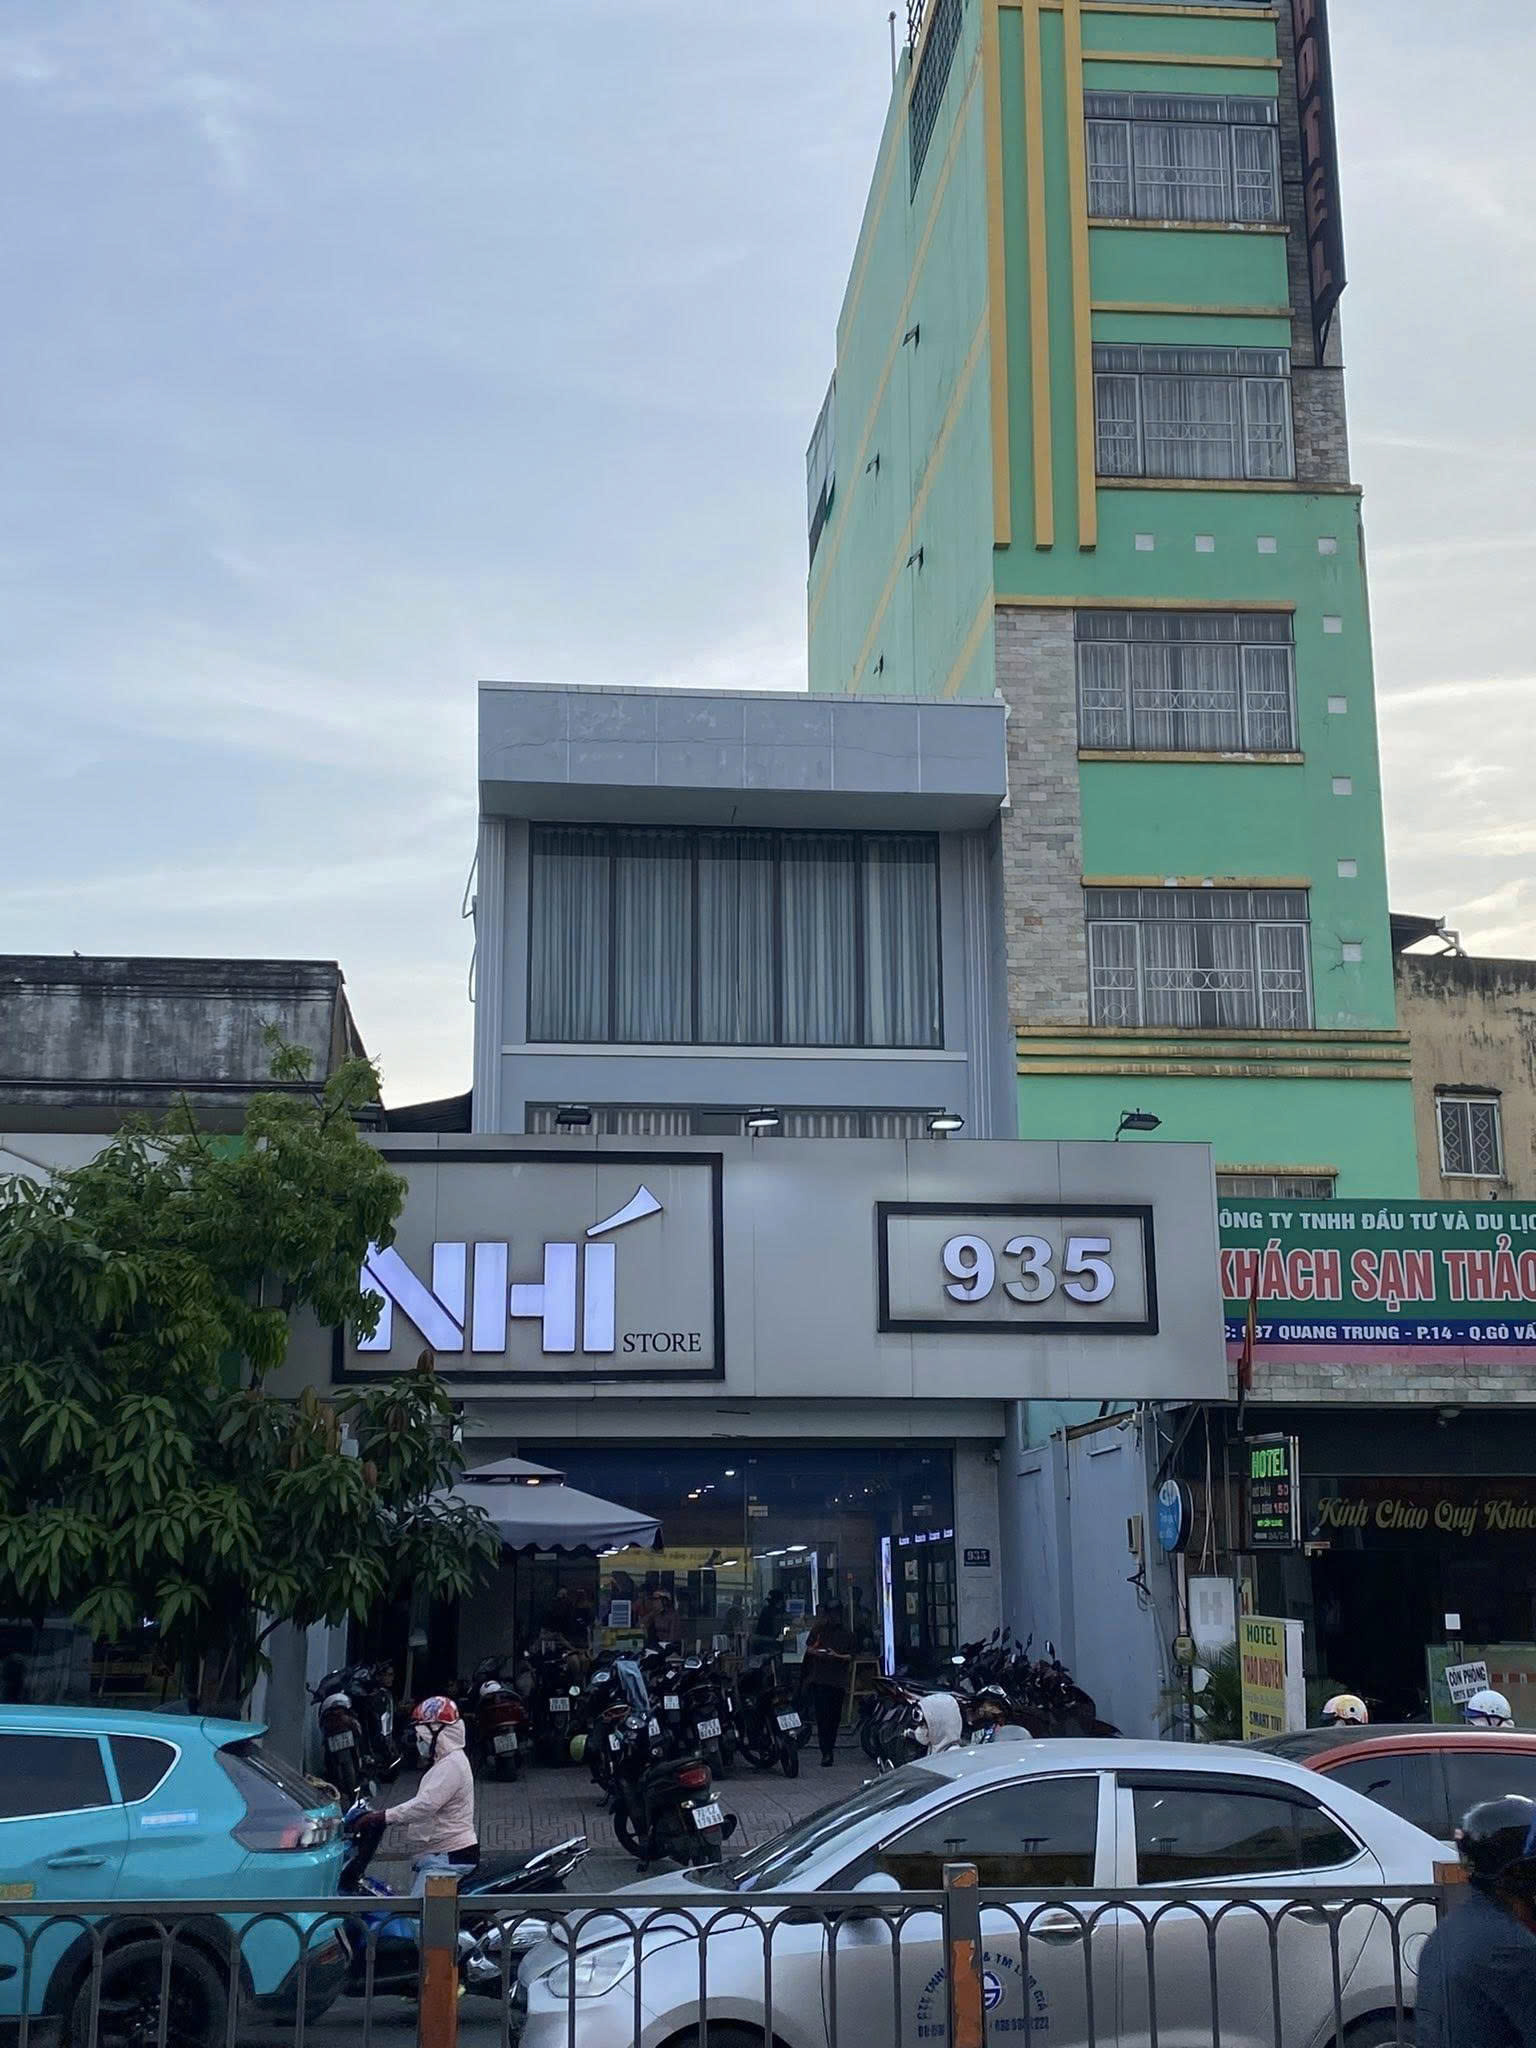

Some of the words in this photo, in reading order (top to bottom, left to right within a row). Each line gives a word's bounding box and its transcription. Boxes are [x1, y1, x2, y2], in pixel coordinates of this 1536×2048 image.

[1269, 1212, 1293, 1229] TY
[1300, 1213, 1356, 1230] TNHH
[1361, 1208, 1404, 1230] ĐẦU
[1410, 1211, 1438, 1230] TƯ
[1442, 1210, 1470, 1230] VÀ
[1475, 1213, 1504, 1231] DU
[356, 1183, 663, 1353] NHÍ
[941, 1234, 1116, 1305] 935
[1351, 1248, 1436, 1313] SẠN
[1442, 1233, 1536, 1302] THẢO
[623, 1333, 702, 1354] STORE
[1278, 1325, 1337, 1341] QUANG
[1342, 1325, 1400, 1340] TRUNG
[1416, 1326, 1452, 1340] P.14
[1469, 1323, 1509, 1342] Q.GÒ
[1251, 1447, 1289, 1479] HOTEL
[1318, 1497, 1369, 1528] Kính
[1375, 1499, 1429, 1530] Chào
[1246, 1623, 1278, 1646] HOTEL
